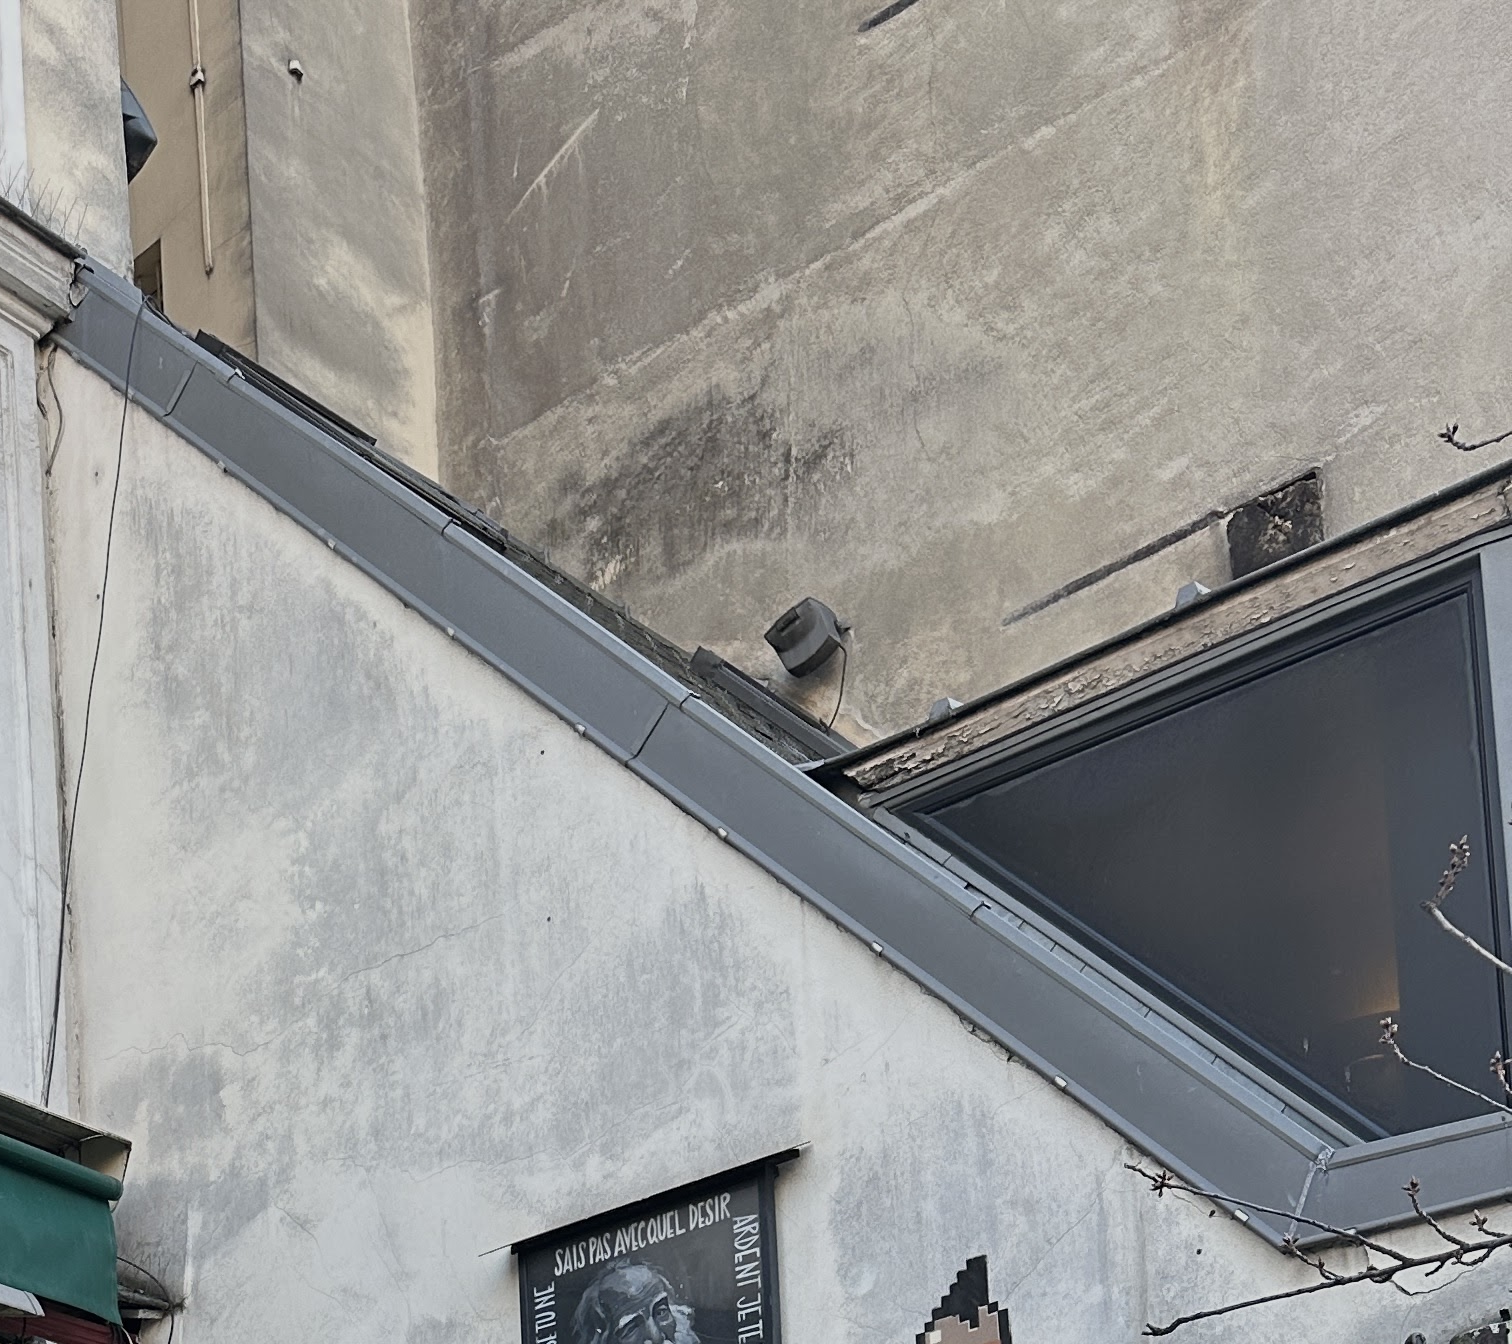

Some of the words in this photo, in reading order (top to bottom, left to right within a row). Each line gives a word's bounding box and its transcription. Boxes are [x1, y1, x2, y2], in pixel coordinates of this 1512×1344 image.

[554, 1242, 586, 1277] SAIS
[589, 1231, 611, 1265] PAS
[613, 1222, 647, 1258] AVEC
[647, 1210, 686, 1243] QUEL
[688, 1192, 732, 1231] DESIR
[732, 1214, 762, 1288] ARDENT
[533, 1281, 556, 1310] NE
[736, 1292, 762, 1322] JE
[535, 1311, 557, 1334] TU
[738, 1319, 764, 1344] TE
